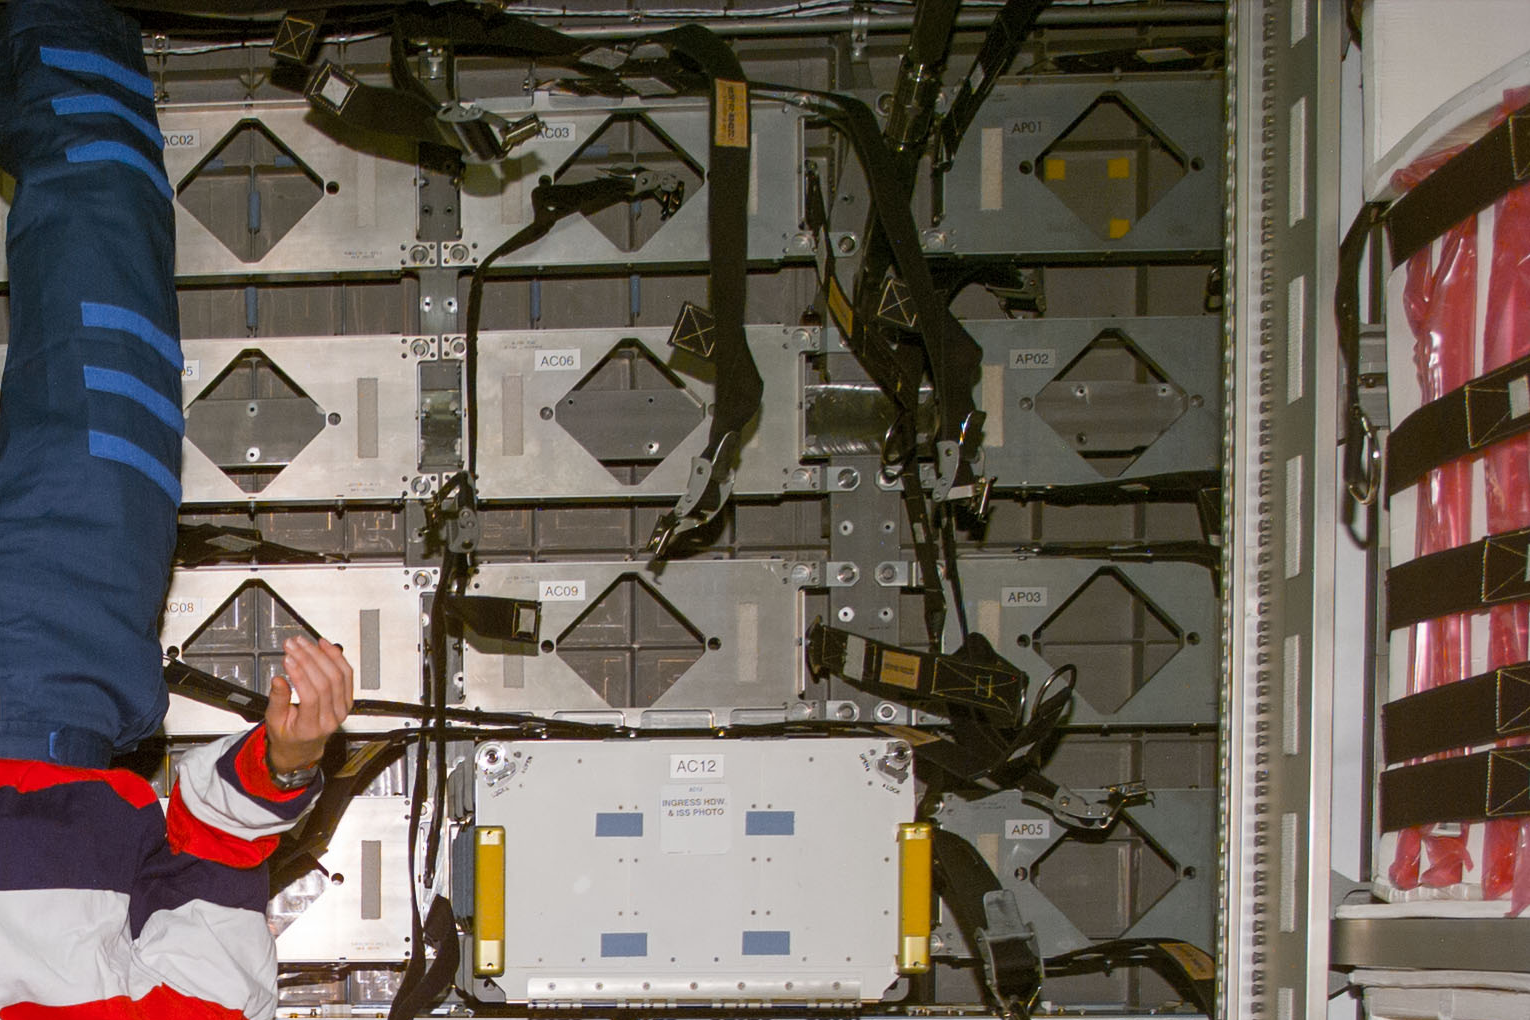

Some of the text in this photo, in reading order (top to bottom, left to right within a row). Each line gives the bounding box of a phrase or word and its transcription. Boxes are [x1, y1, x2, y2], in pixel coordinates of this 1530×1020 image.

[540, 355, 574, 367] AC06
[1015, 353, 1049, 365] AP02
[544, 585, 579, 597] AC09
[1007, 591, 1041, 603] AP03
[676, 760, 717, 773] AC12
[662, 797, 702, 807] INGRESS
[693, 808, 724, 817] PHOTO
[1011, 823, 1043, 836] AP05
